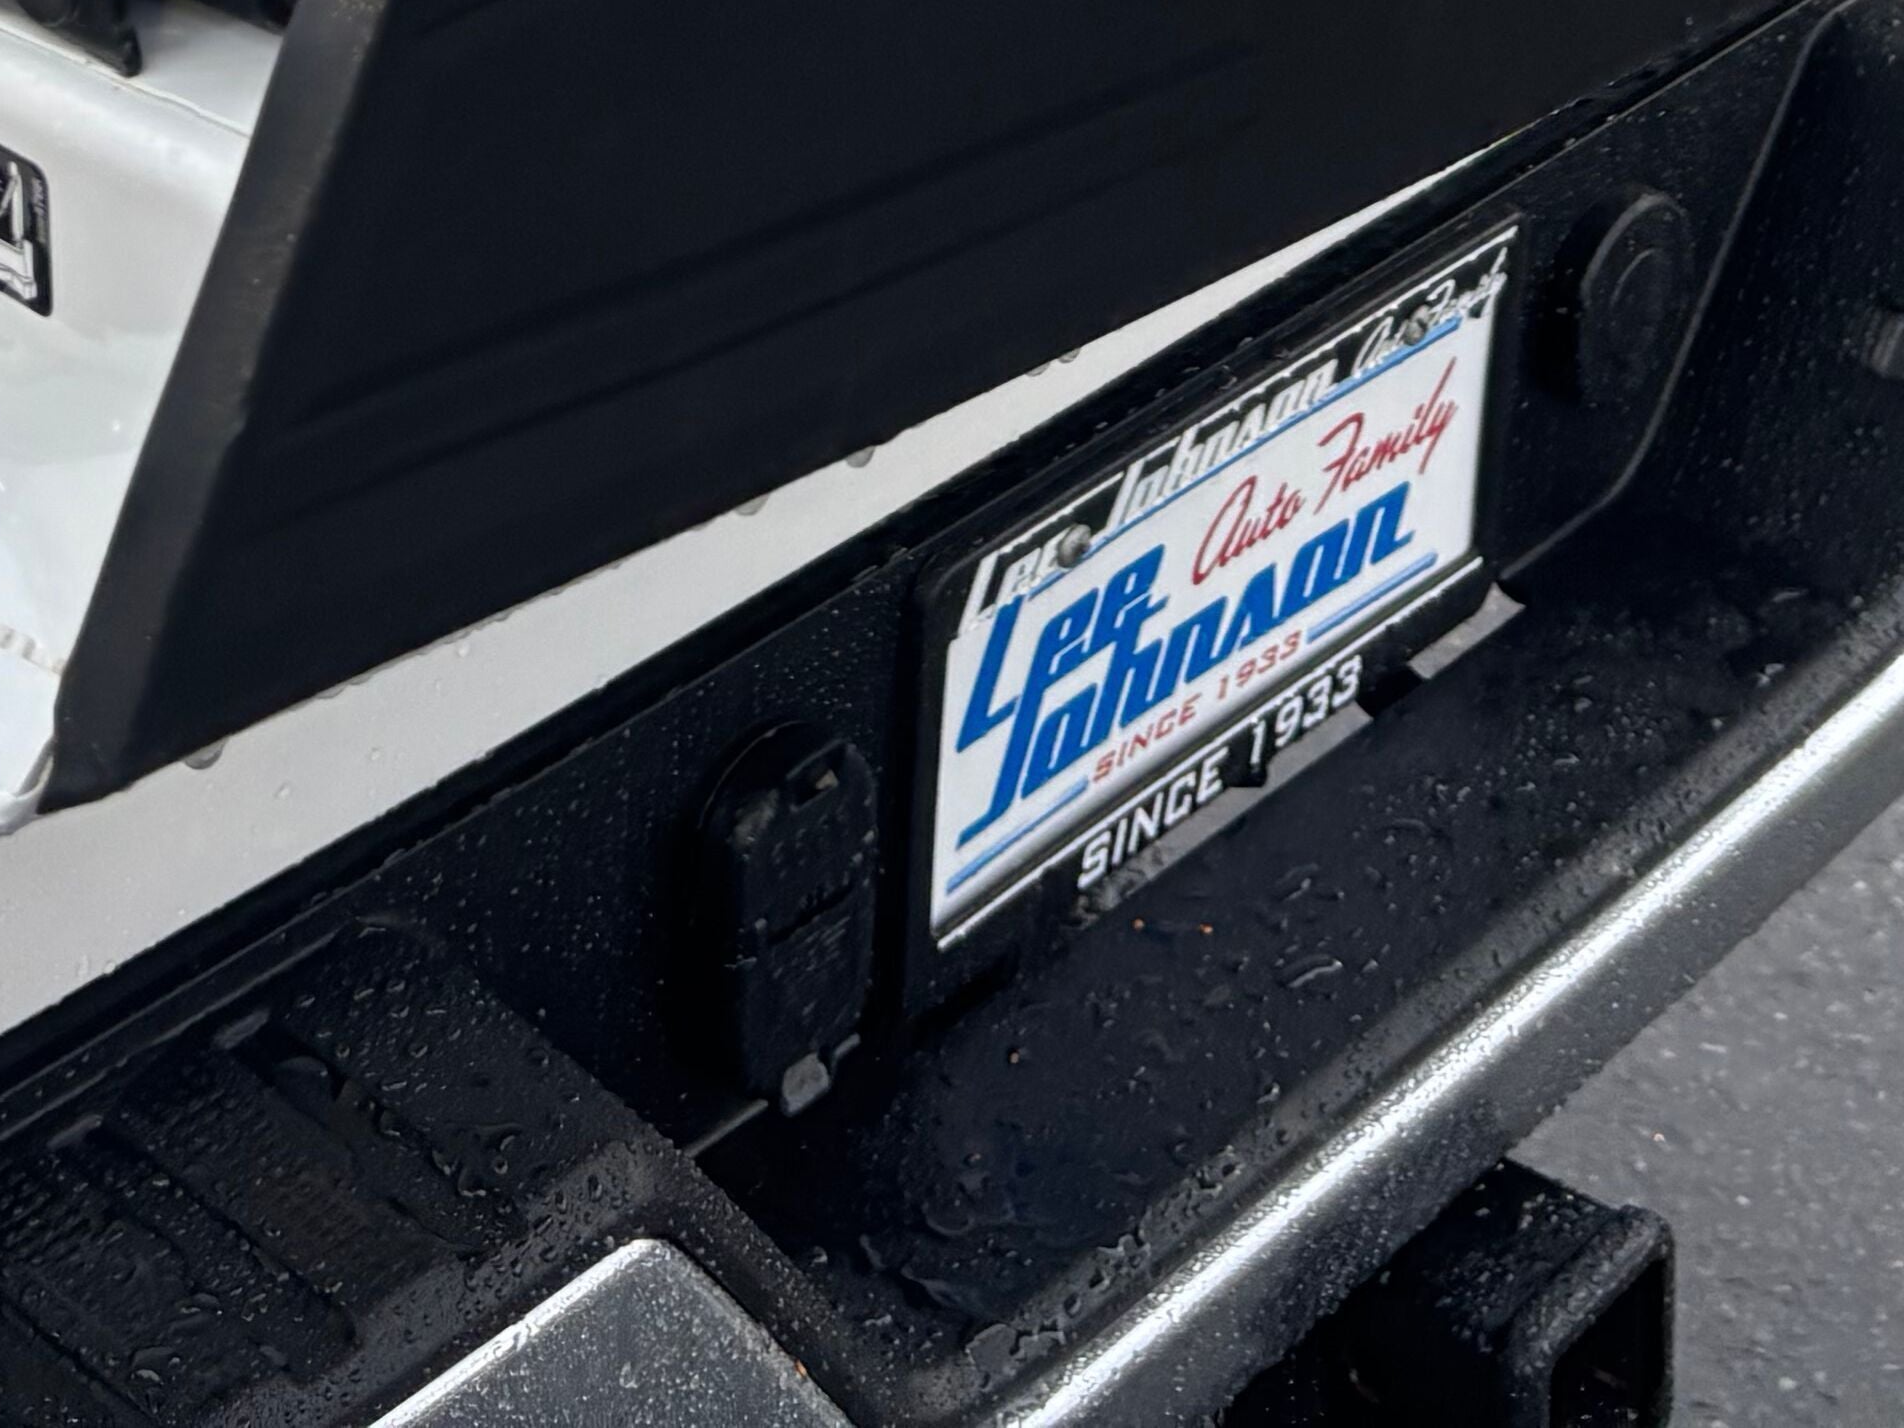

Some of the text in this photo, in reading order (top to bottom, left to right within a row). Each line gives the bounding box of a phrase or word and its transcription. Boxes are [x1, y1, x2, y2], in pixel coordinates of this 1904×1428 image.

[957, 529, 1086, 638] Le
[1350, 315, 1424, 380] Aut
[1191, 355, 1458, 586] Auto Family
[955, 481, 1416, 851] Johnson
[956, 543, 1171, 754] Lee
[1091, 629, 1302, 783] SINCE 1933
[1076, 654, 1364, 891] SINCE 1933
